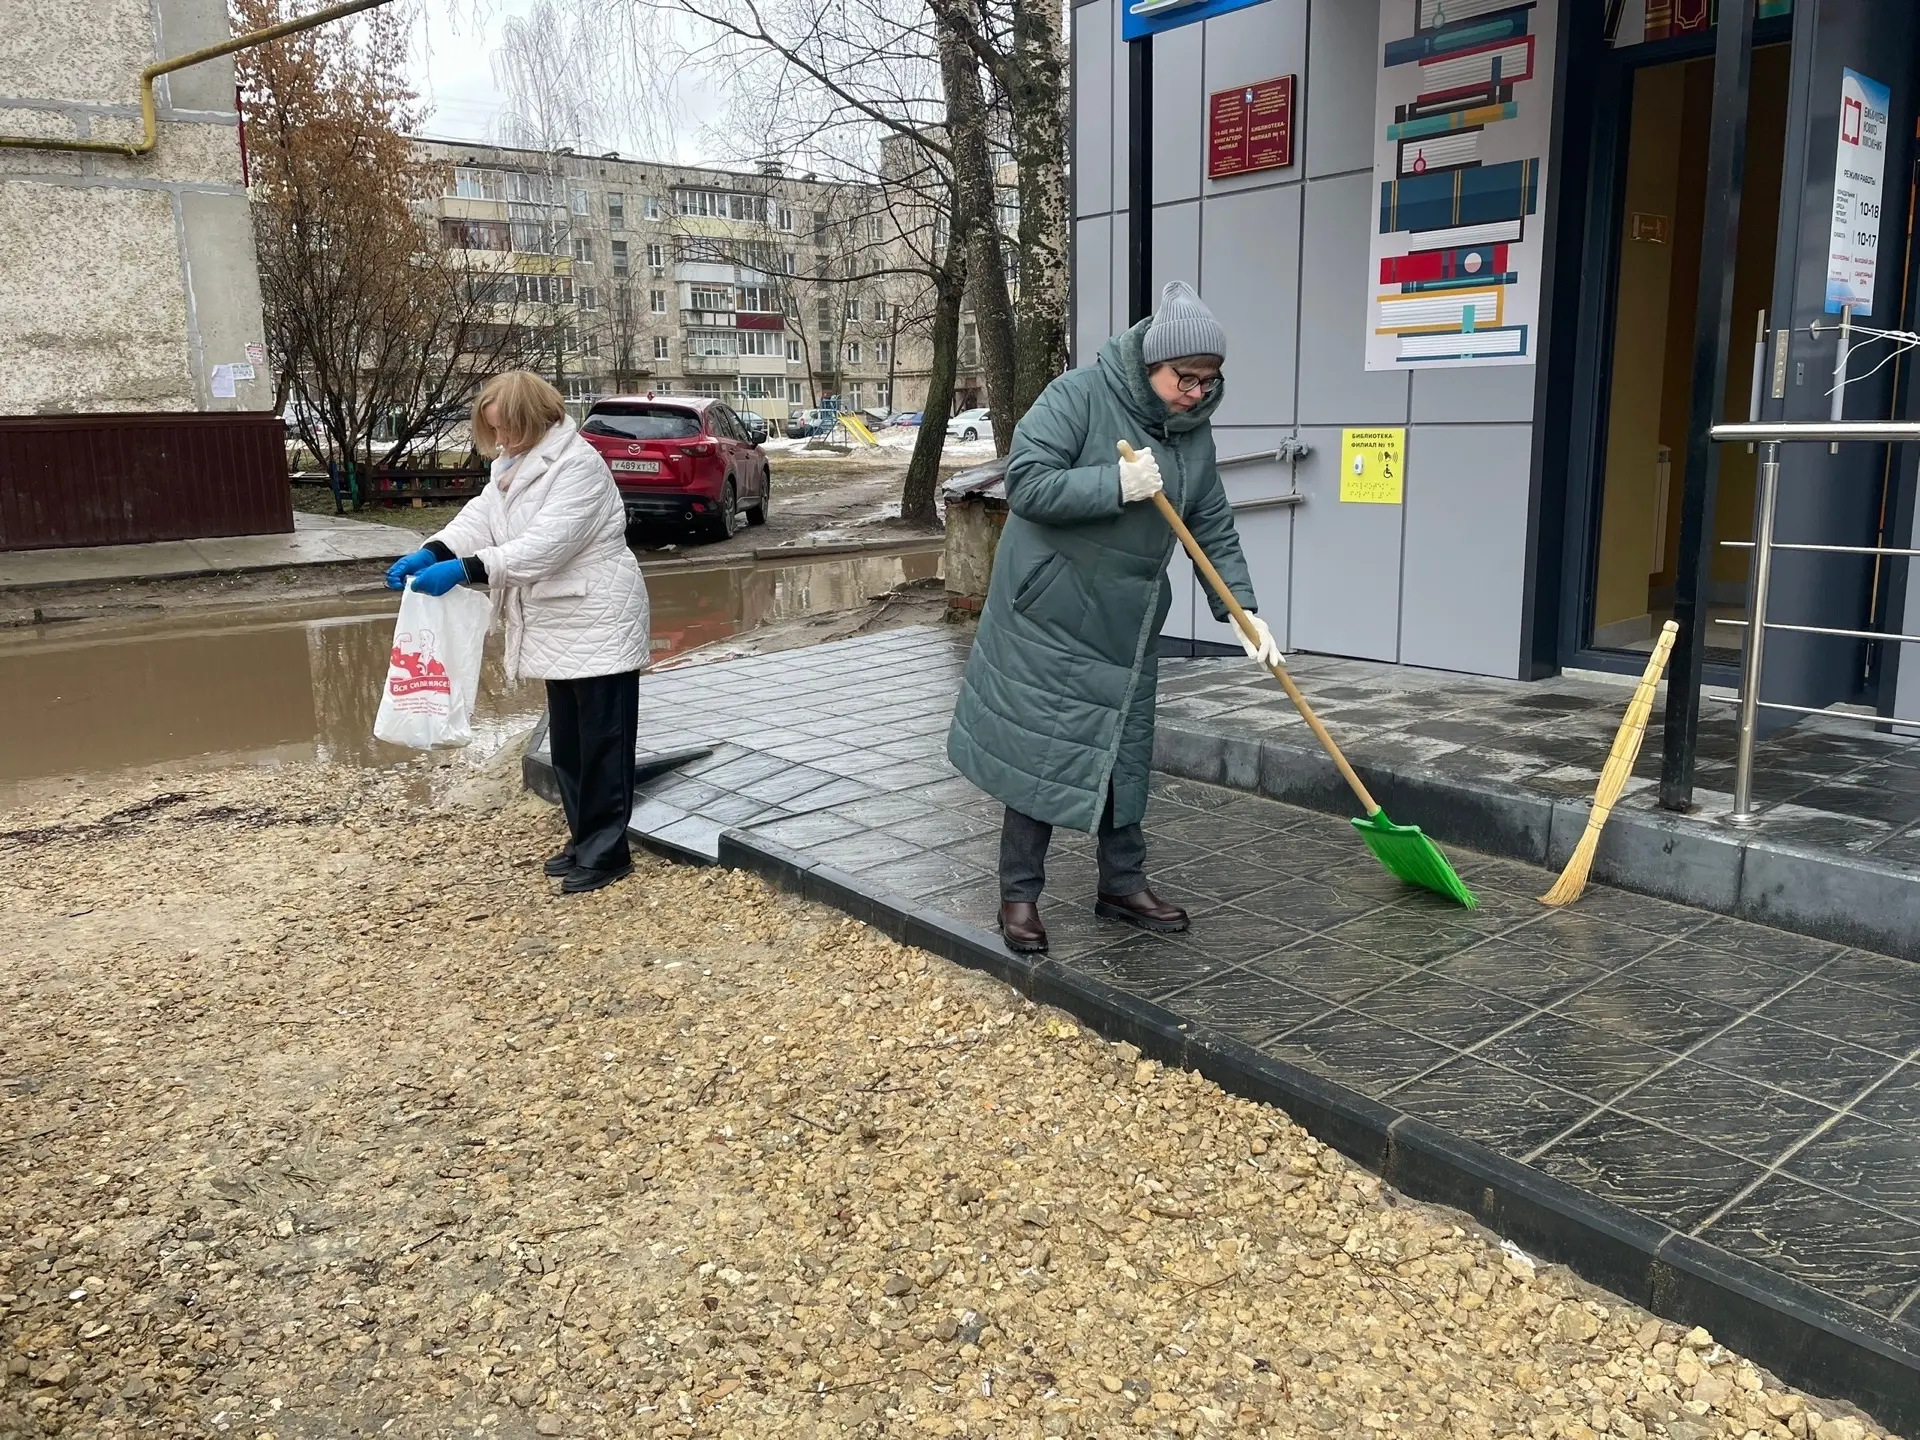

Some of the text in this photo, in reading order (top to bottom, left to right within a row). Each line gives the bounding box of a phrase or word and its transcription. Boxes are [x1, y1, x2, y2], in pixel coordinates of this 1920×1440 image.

[1250, 132, 1272, 141] ФИЛИАЛ
[1860, 201, 1880, 219] 10-18
[1857, 231, 1877, 248] 10-17
[393, 683, 408, 692] Вся
